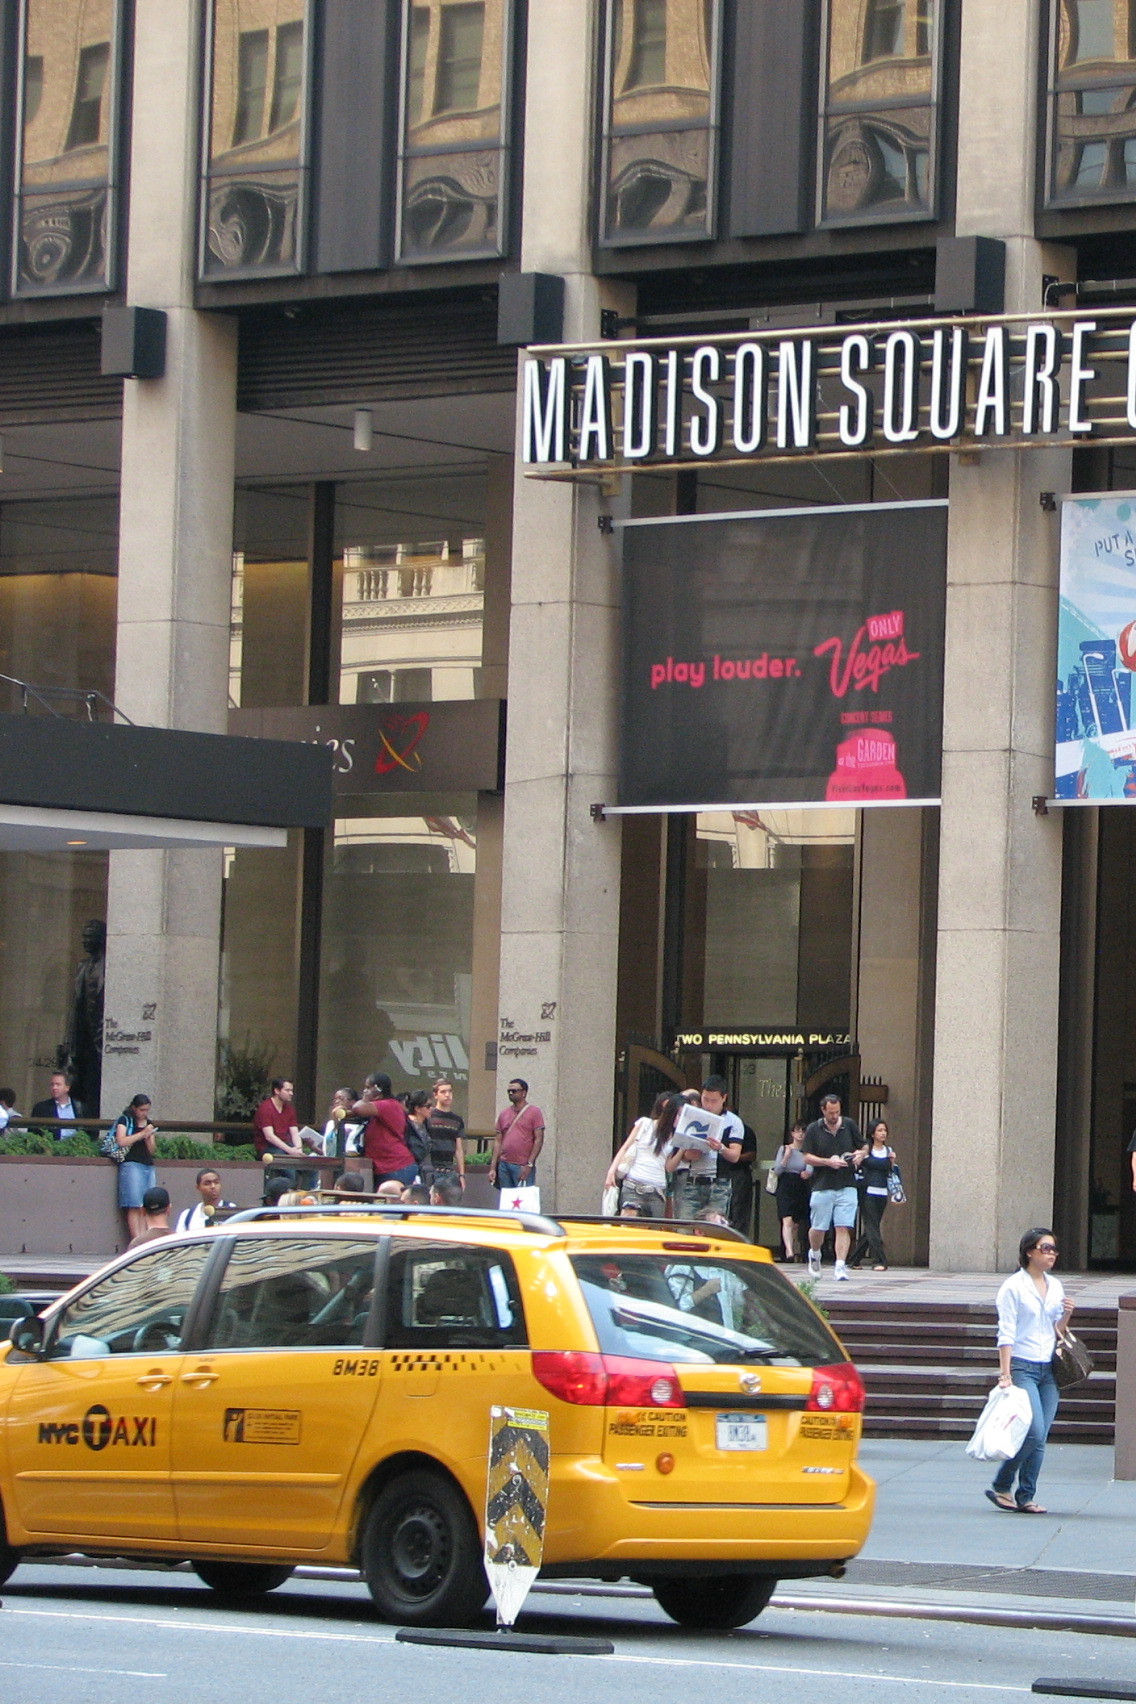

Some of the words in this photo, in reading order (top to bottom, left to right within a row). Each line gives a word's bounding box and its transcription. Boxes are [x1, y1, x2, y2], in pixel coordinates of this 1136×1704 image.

[523, 339, 813, 462] MADISON
[839, 321, 1097, 446] SQUARE
[1094, 532, 1121, 557] PUT
[1124, 530, 1134, 547] A
[869, 614, 901, 638] ONLY
[814, 626, 921, 697] Vegas
[651, 656, 707, 690] play
[713, 652, 801, 681] louder.
[857, 739, 896, 761] GARDEN
[500, 1017, 514, 1028] The
[500, 1031, 551, 1042] McGraw-Hill
[676, 1033, 703, 1045] TWO
[708, 1033, 804, 1045] PENNSYLVANIA
[809, 1033, 851, 1045] PLAZA
[499, 1044, 538, 1058] Companies
[648, 1411, 686, 1422] CAUTION
[801, 1415, 829, 1426] CAUTION
[38, 1422, 80, 1445] NYC
[85, 1411, 157, 1447] TAXI
[609, 1423, 655, 1437] PASSENGER
[657, 1424, 688, 1438] EXITING
[800, 1427, 831, 1440] PASSENGER
